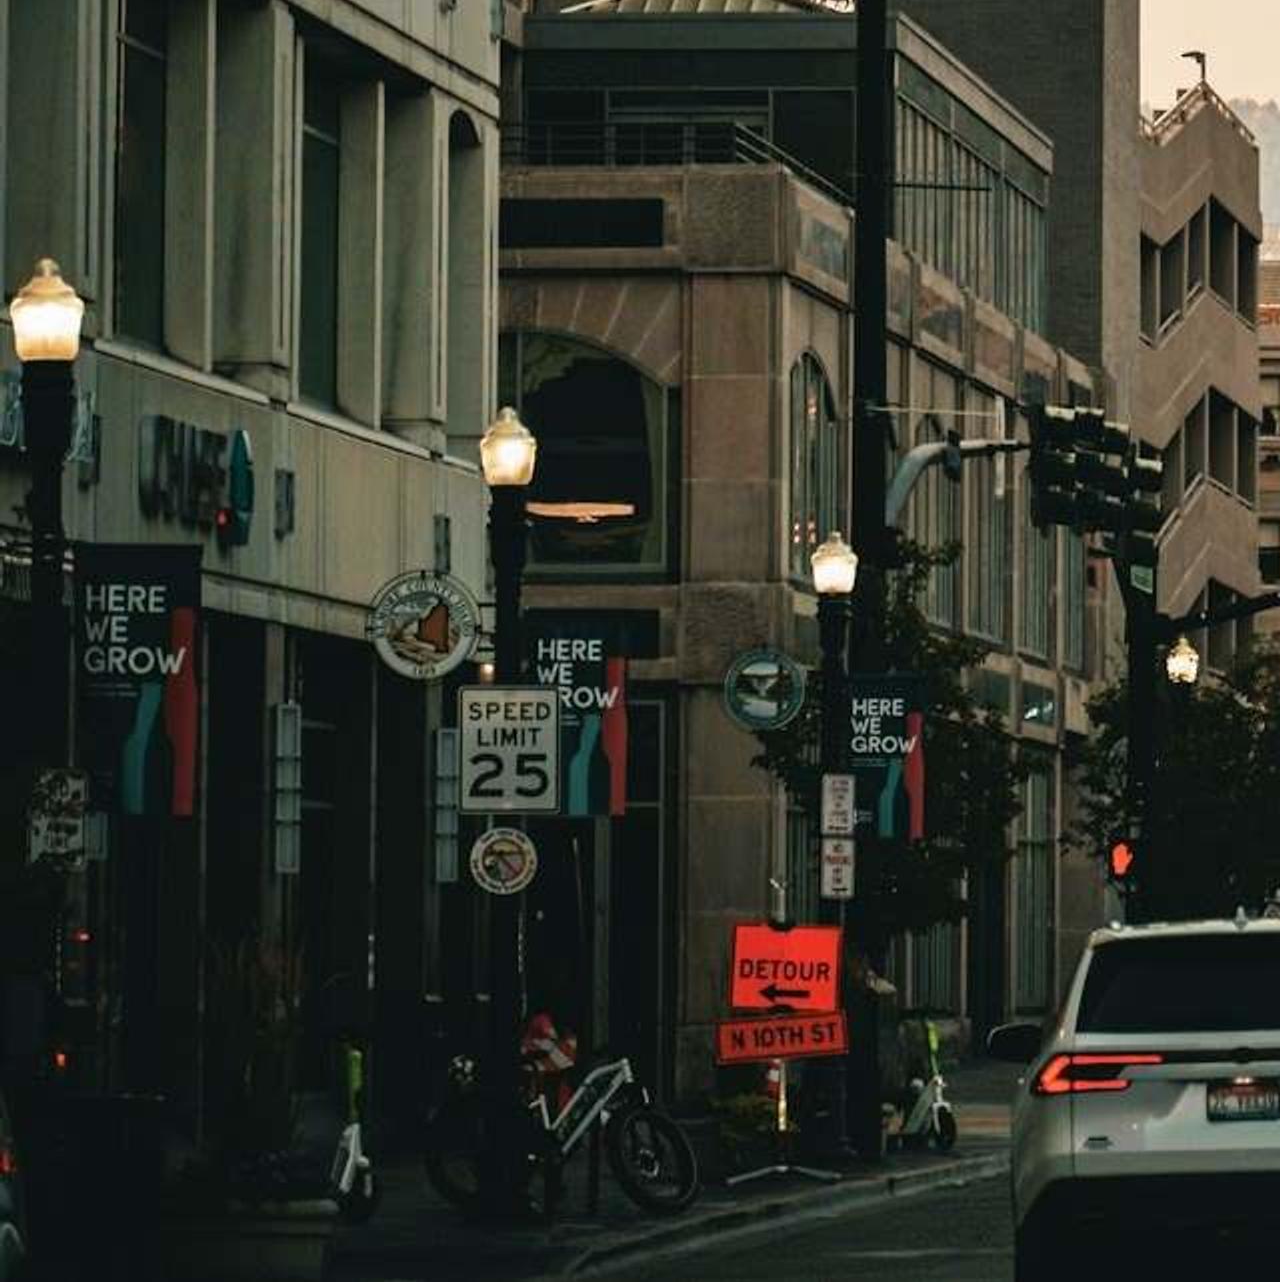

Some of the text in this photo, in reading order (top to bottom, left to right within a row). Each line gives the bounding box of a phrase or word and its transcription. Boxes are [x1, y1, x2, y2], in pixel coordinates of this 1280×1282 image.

[86, 585, 166, 614] HERE
[86, 615, 128, 643] WE
[85, 645, 188, 675] GROW
[537, 640, 603, 662] HERE
[537, 663, 573, 685] WE
[557, 685, 620, 710] ROW
[852, 698, 905, 717] HERE
[469, 702, 551, 721] SPEED
[477, 727, 541, 747] LIMIT
[852, 717, 882, 735] WE
[852, 735, 918, 755] GROW
[468, 753, 549, 798] 25
[739, 958, 831, 982] DETOUR
[731, 1023, 839, 1052] N 10TH ST
